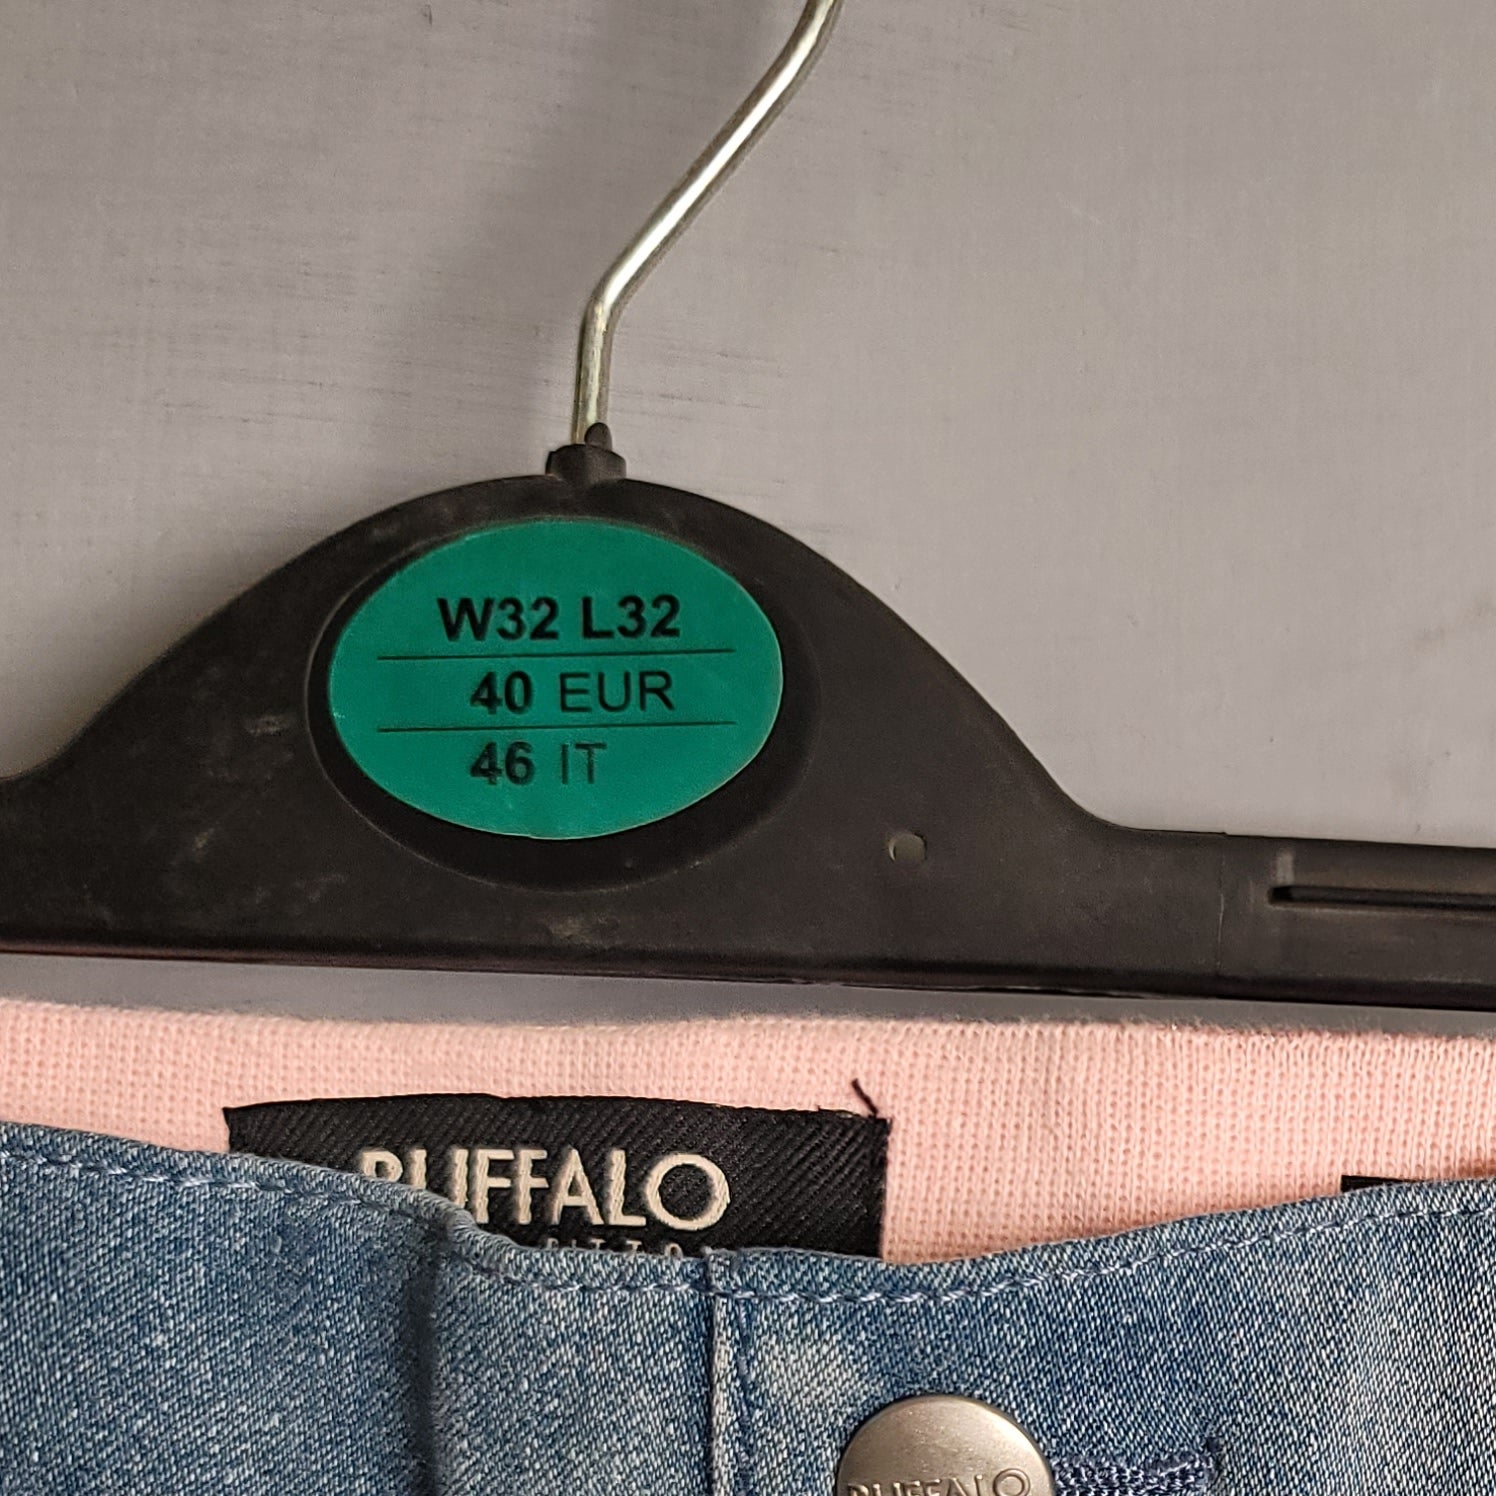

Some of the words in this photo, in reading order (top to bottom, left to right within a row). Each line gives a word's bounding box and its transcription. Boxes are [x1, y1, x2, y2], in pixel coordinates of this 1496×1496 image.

[437, 596, 559, 641] W32
[581, 594, 682, 640] L32
[469, 670, 533, 714] 40
[559, 670, 675, 713] EUR
[469, 741, 536, 785] 46
[560, 742, 607, 785] IT
